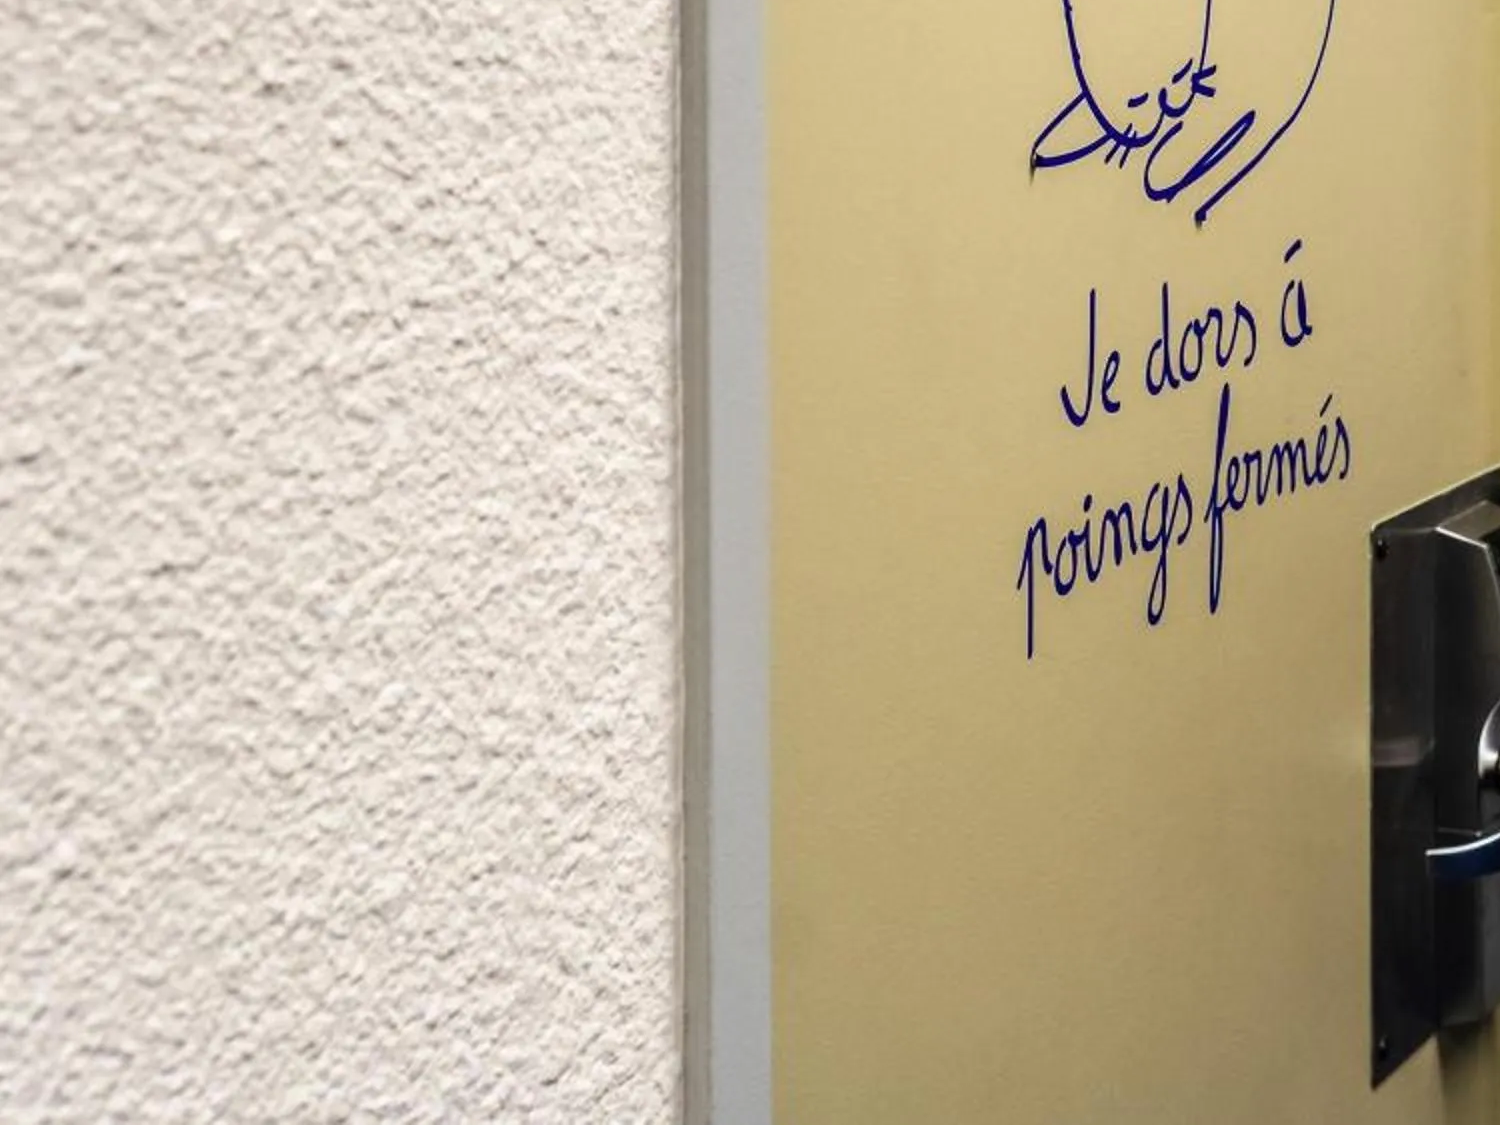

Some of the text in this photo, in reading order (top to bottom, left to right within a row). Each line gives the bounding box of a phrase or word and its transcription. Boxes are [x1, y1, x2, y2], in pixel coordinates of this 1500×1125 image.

[1060, 288, 1121, 426] Je
[1146, 282, 1257, 396] dors
[1017, 383, 1350, 660] poings fermés
